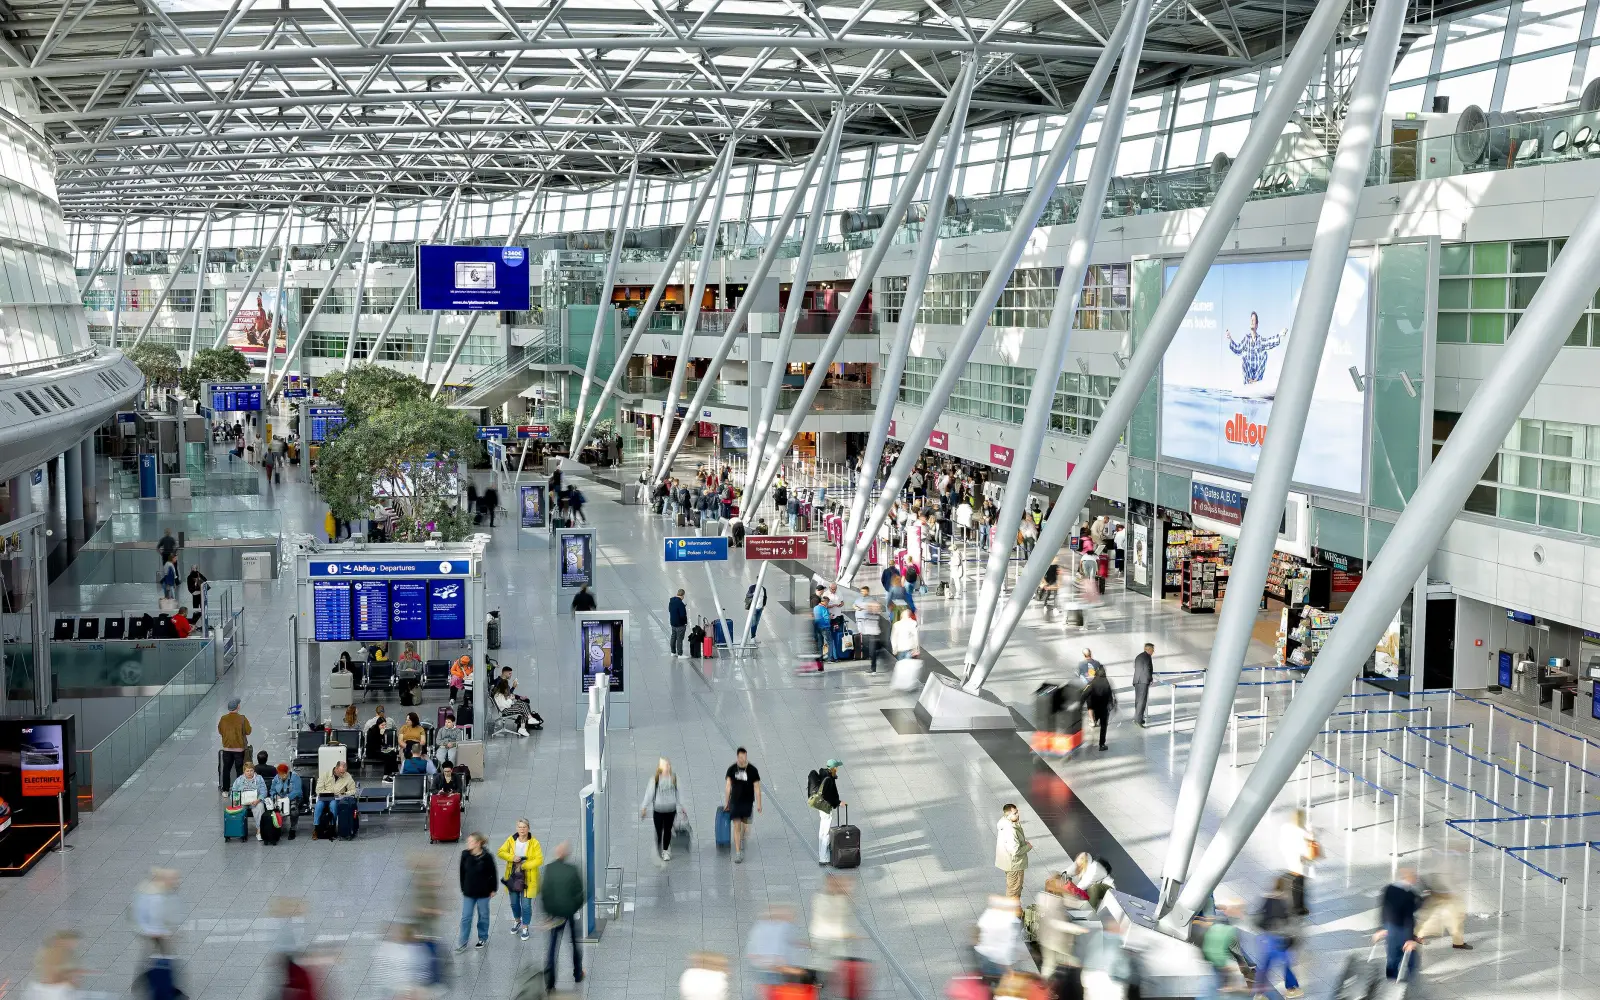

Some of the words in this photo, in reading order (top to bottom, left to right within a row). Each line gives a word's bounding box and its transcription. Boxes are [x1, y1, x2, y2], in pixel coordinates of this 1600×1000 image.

[1225, 413, 1268, 447] alltou
[1204, 487, 1219, 500] Gates
[1324, 551, 1348, 566] WHSmith
[353, 565, 376, 573] Abflug
[380, 565, 416, 573] Departures
